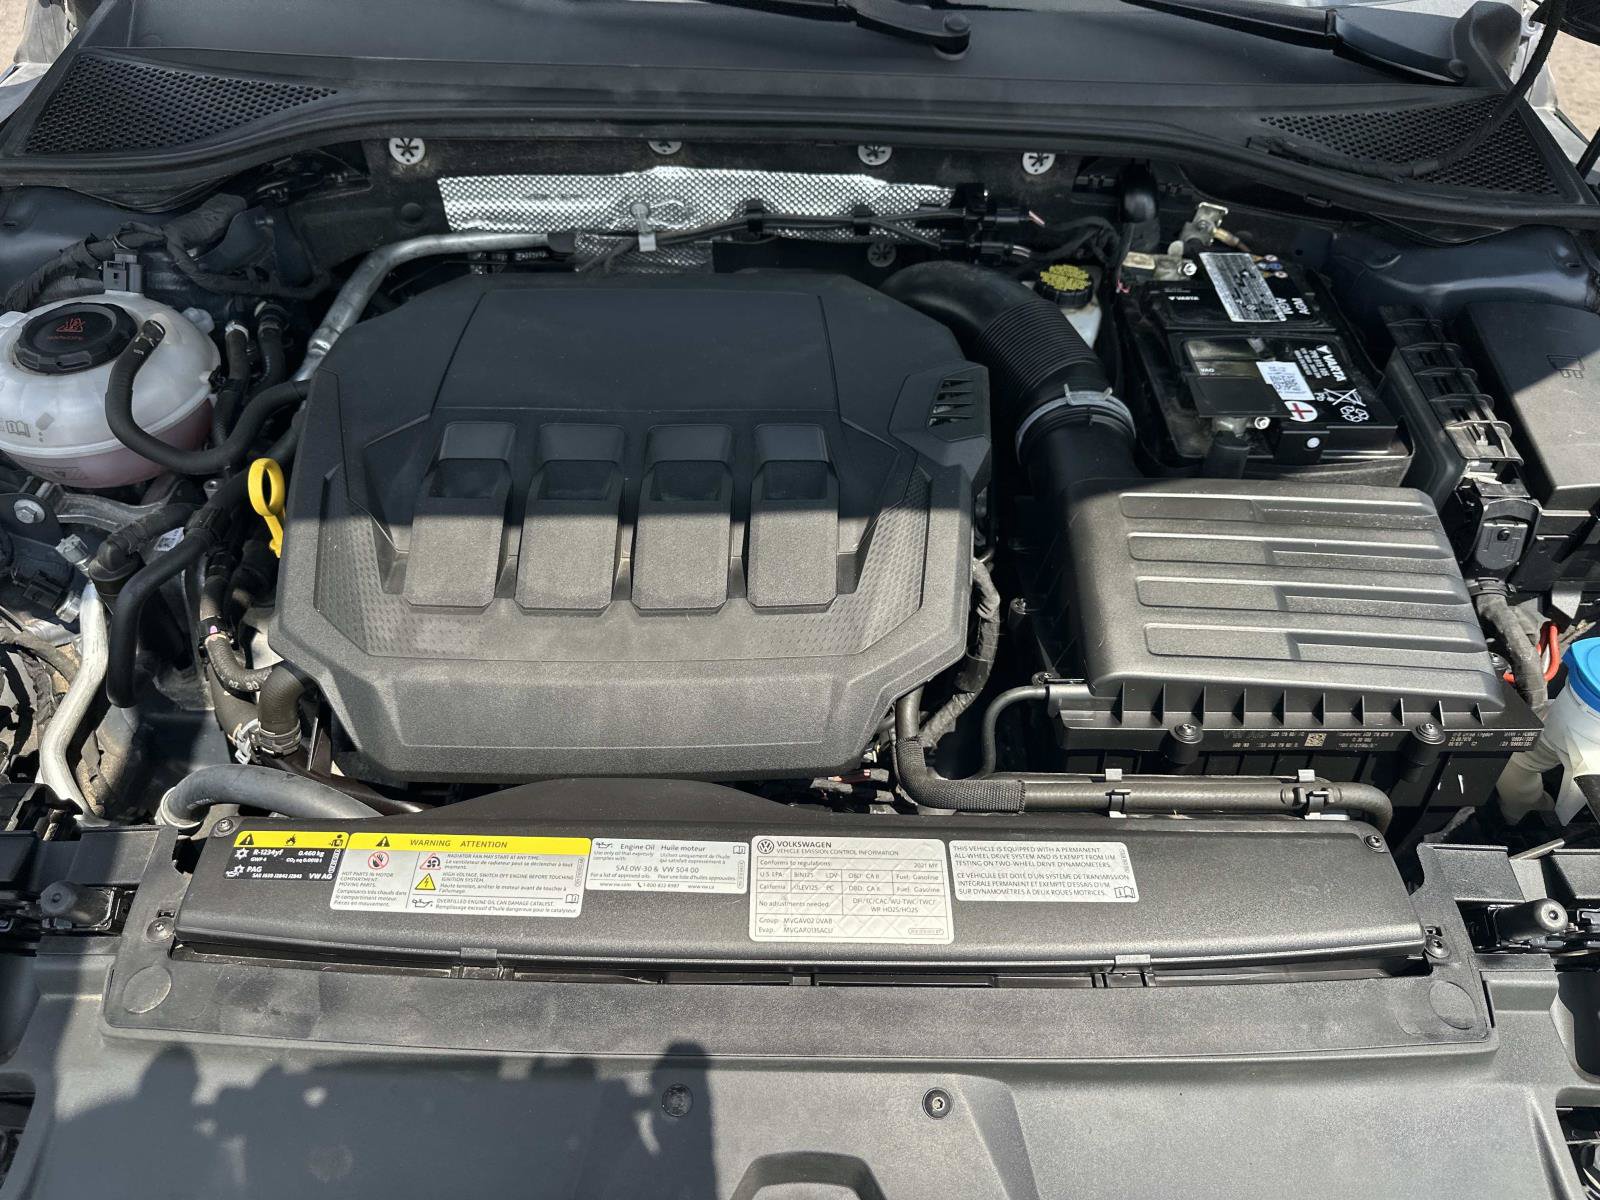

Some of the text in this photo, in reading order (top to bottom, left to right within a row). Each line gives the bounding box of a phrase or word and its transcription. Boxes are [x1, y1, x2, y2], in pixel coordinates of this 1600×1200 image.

[1323, 354, 1347, 382] VARTA
[620, 843, 643, 851] Engine
[776, 840, 832, 848] VOLKSWAGEN
[252, 849, 284, 857] R-1234yf
[316, 850, 325, 858] kg
